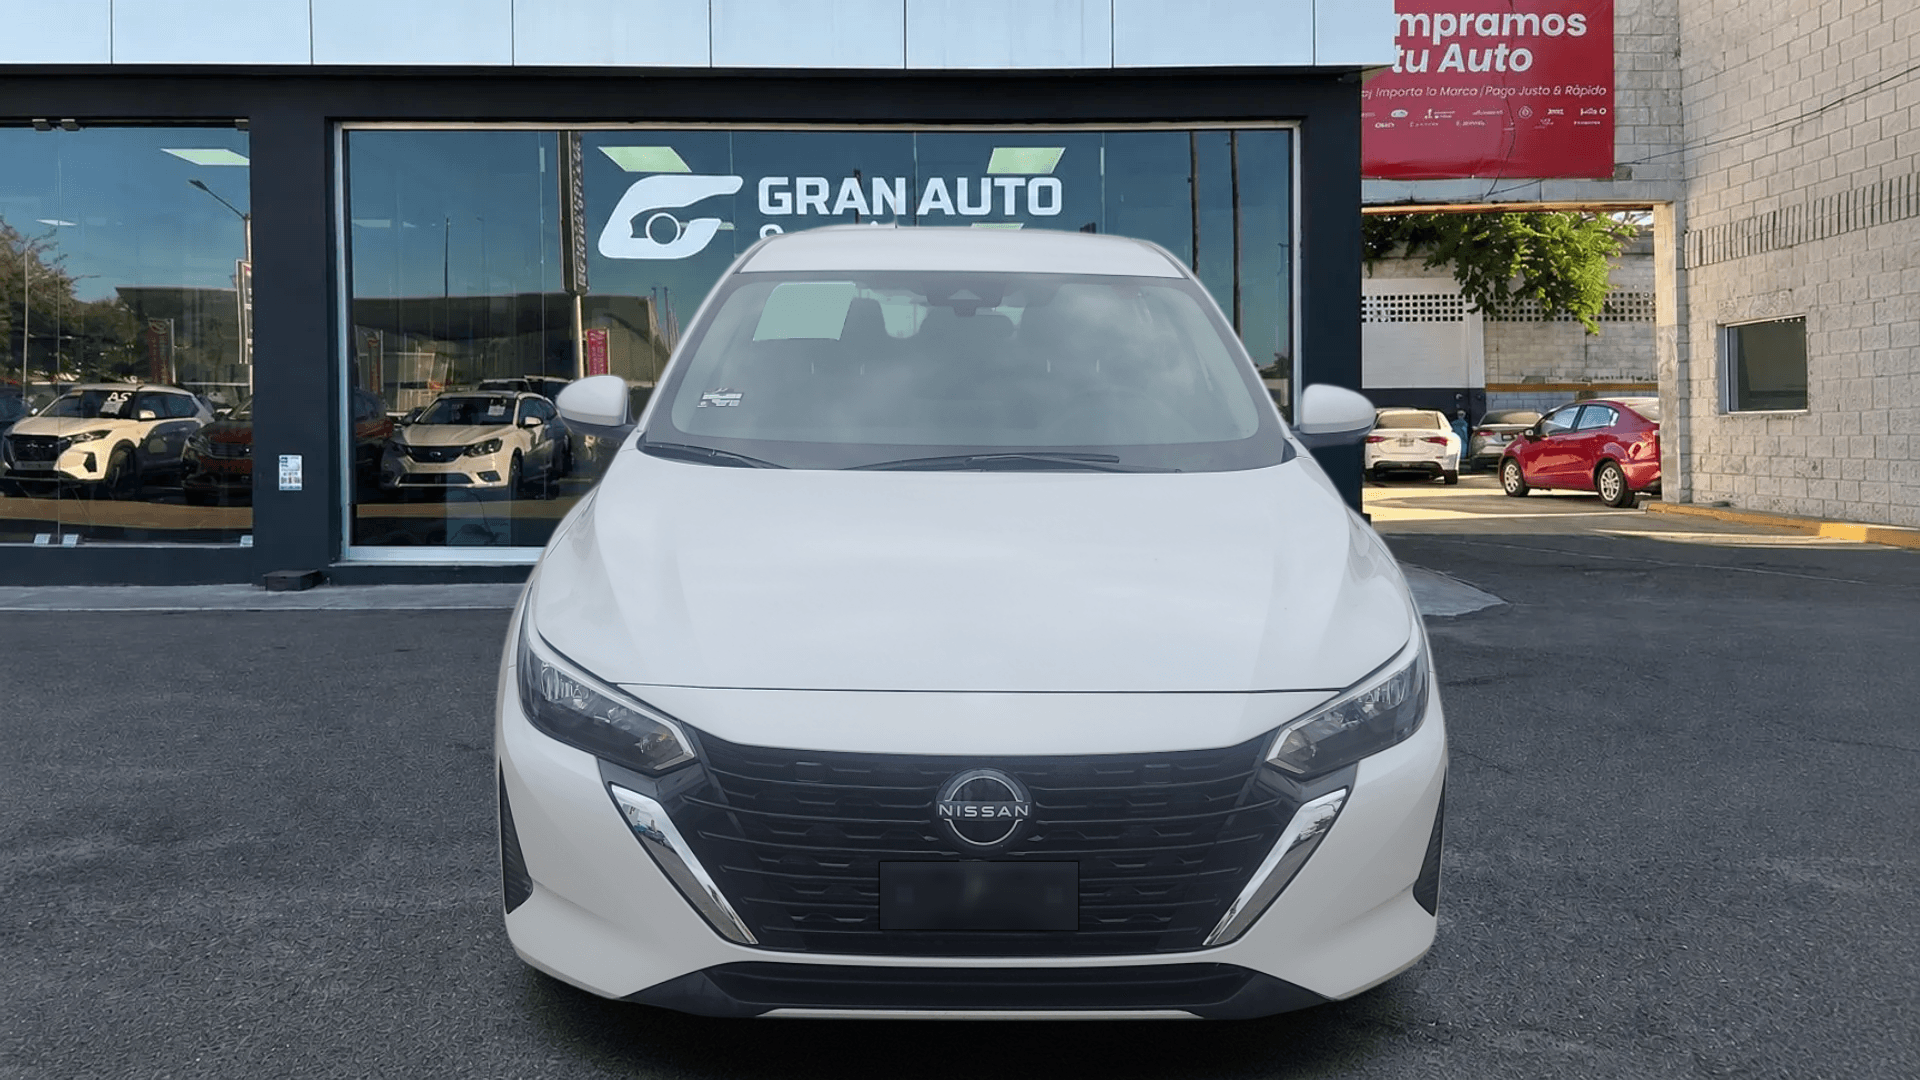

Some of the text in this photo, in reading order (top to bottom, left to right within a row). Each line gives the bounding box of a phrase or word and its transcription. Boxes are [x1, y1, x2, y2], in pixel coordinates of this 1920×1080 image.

[1392, 43, 1533, 73] tu Auto
[1518, 86, 1551, 96] Justo
[1553, 85, 1561, 96] &
[1565, 84, 1607, 98] Rápido
[758, 176, 1063, 216] GRAN AUTO
[938, 804, 1029, 818] NISSAN
